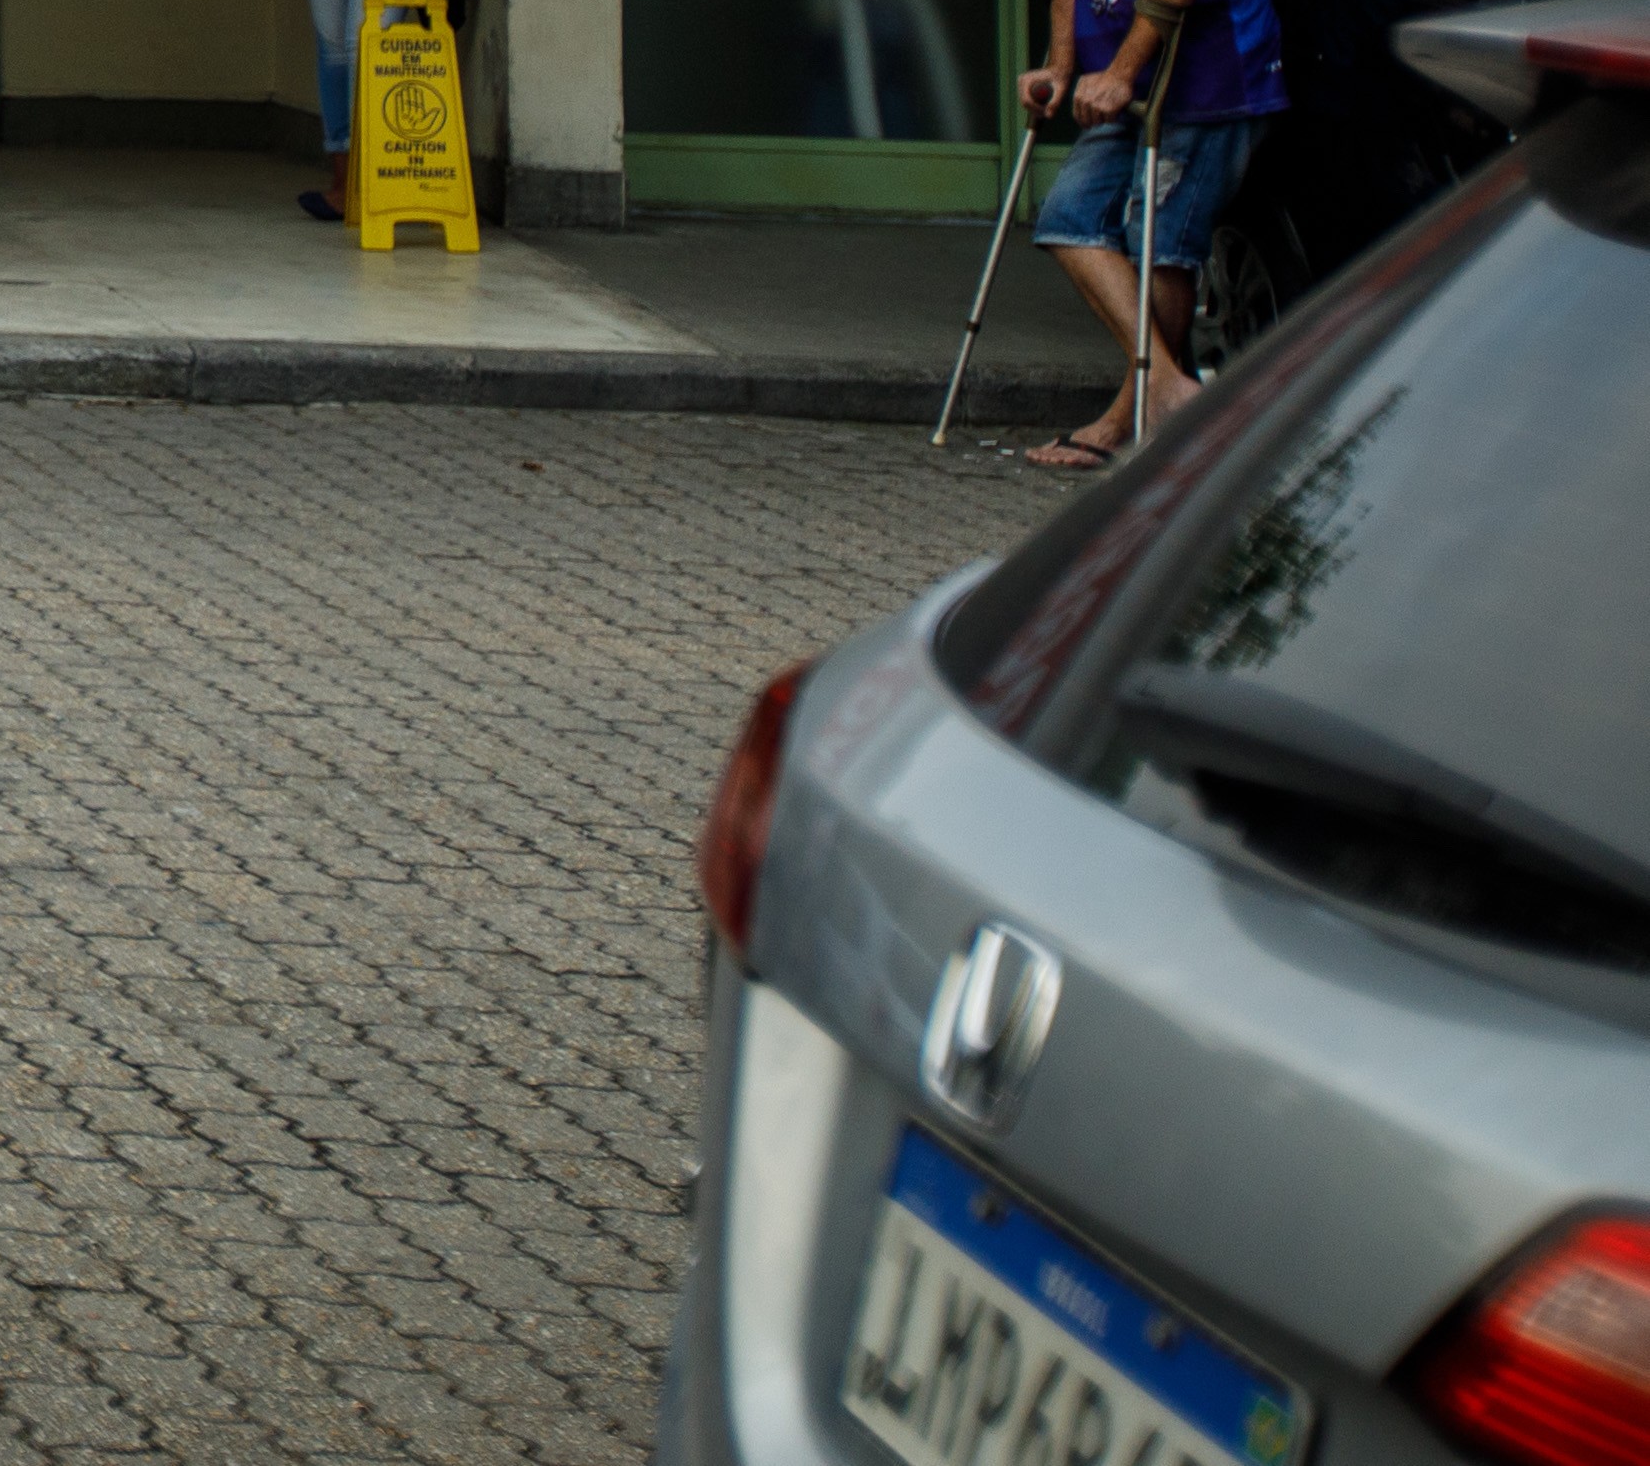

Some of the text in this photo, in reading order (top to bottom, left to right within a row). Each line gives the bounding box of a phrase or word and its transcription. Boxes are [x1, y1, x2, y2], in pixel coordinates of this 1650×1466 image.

[380, 39, 442, 53] CUIDADO
[401, 54, 421, 65] EM
[375, 63, 447, 78] MANUTENÇÃO
[384, 141, 446, 153] CAUTION
[408, 155, 424, 165] IN
[377, 168, 457, 180] MAINTENANCE
